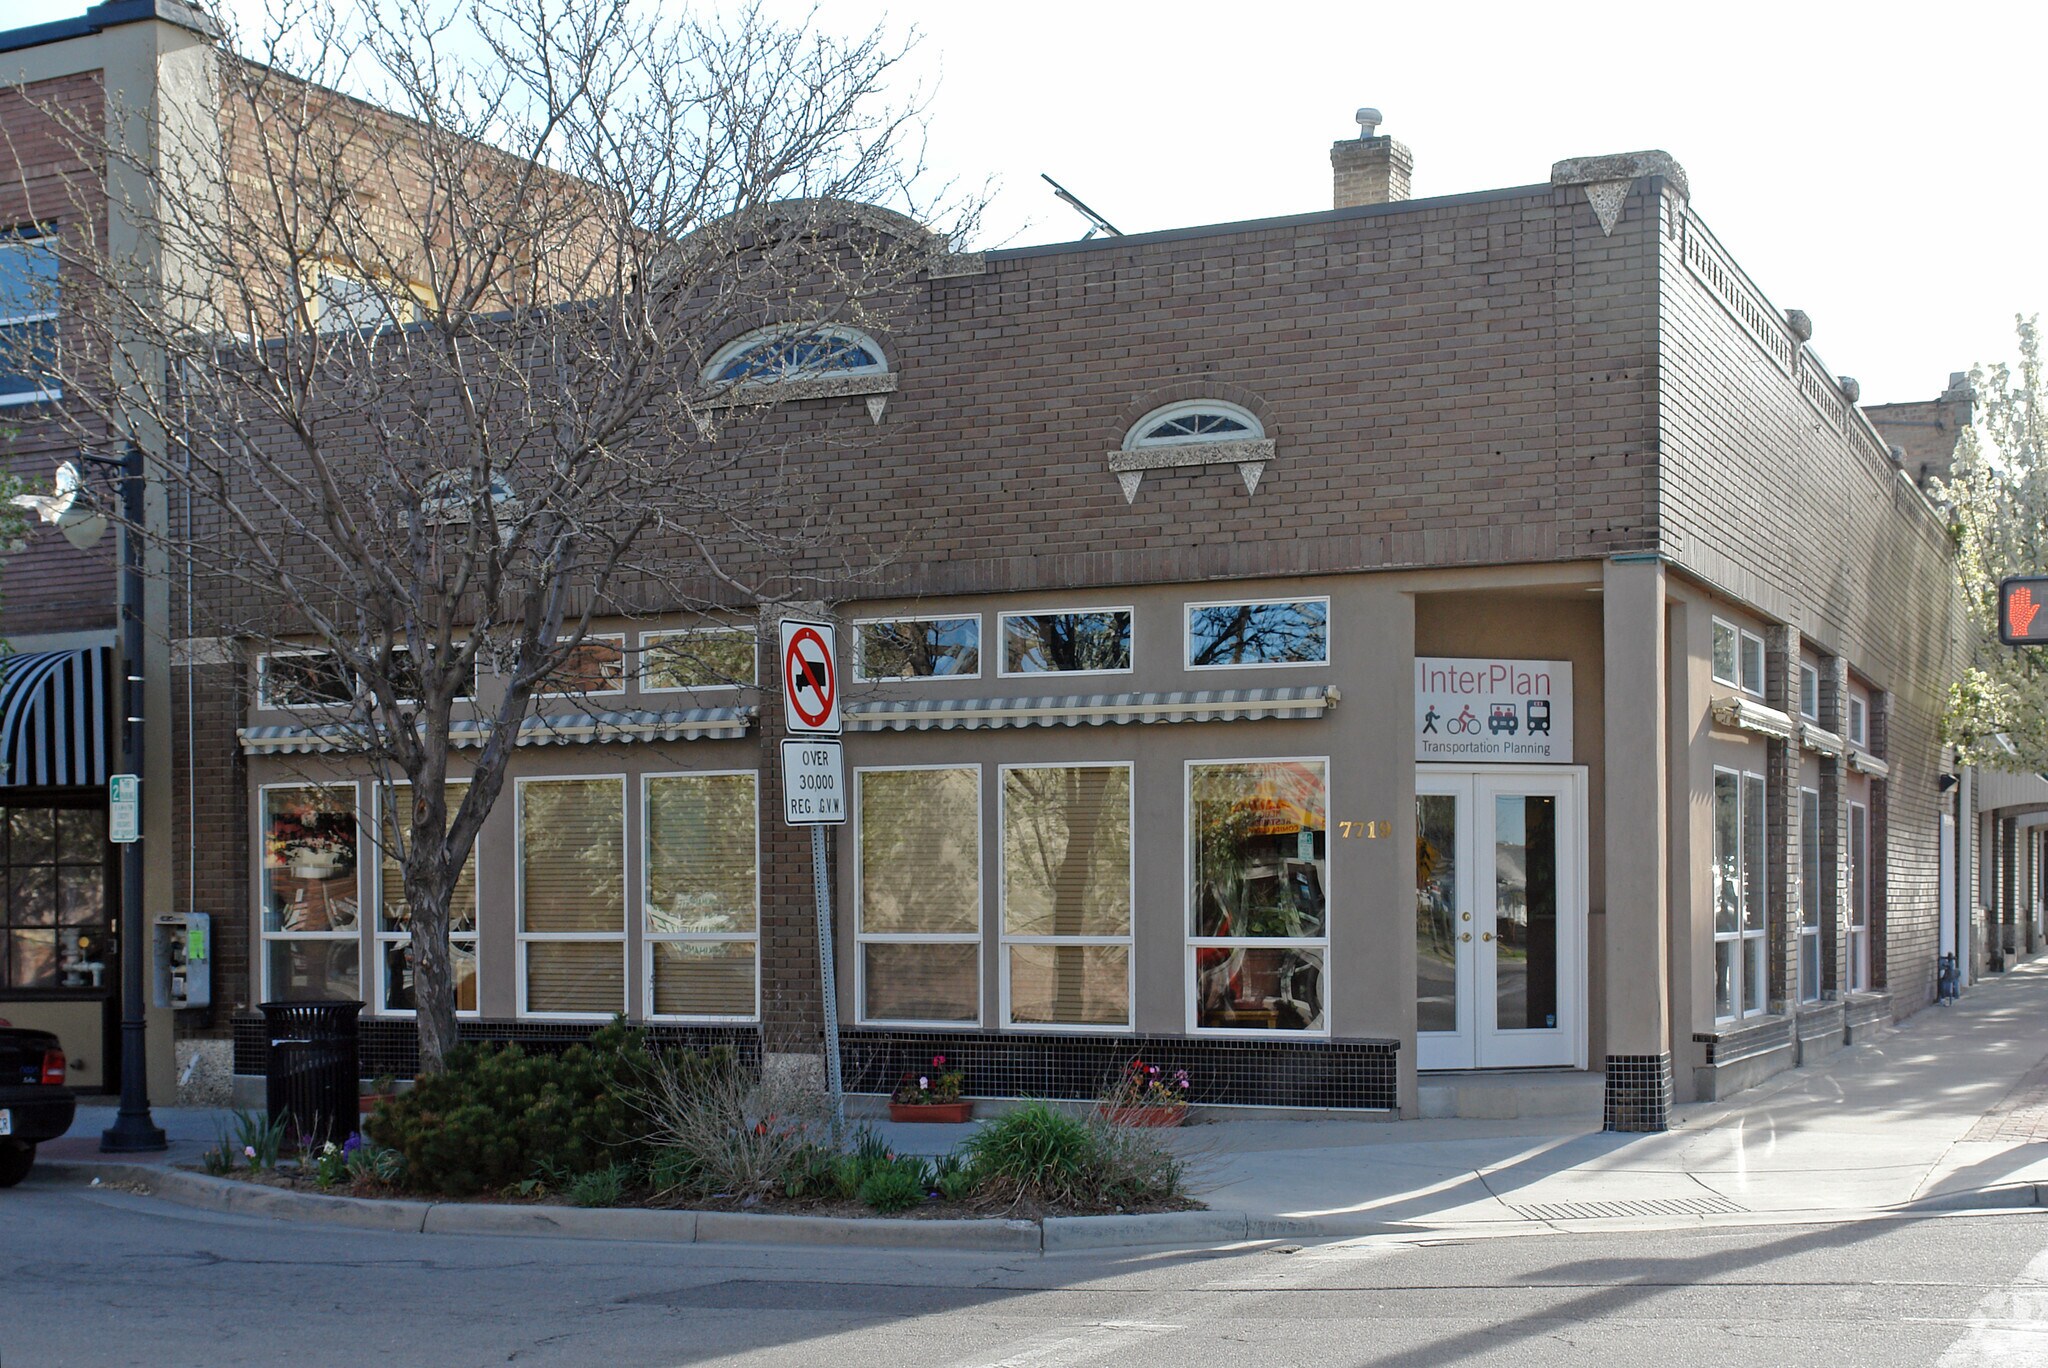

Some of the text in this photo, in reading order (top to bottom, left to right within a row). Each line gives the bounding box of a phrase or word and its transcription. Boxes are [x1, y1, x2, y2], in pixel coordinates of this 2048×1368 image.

[1422, 663, 1550, 695] InterPlan
[1422, 740, 1550, 756] Transportation Planning
[802, 750, 829, 766] OVER
[799, 774, 834, 792] 30,000
[112, 784, 119, 800] 2
[791, 798, 815, 814] REG.
[1339, 820, 1392, 838] 7719
